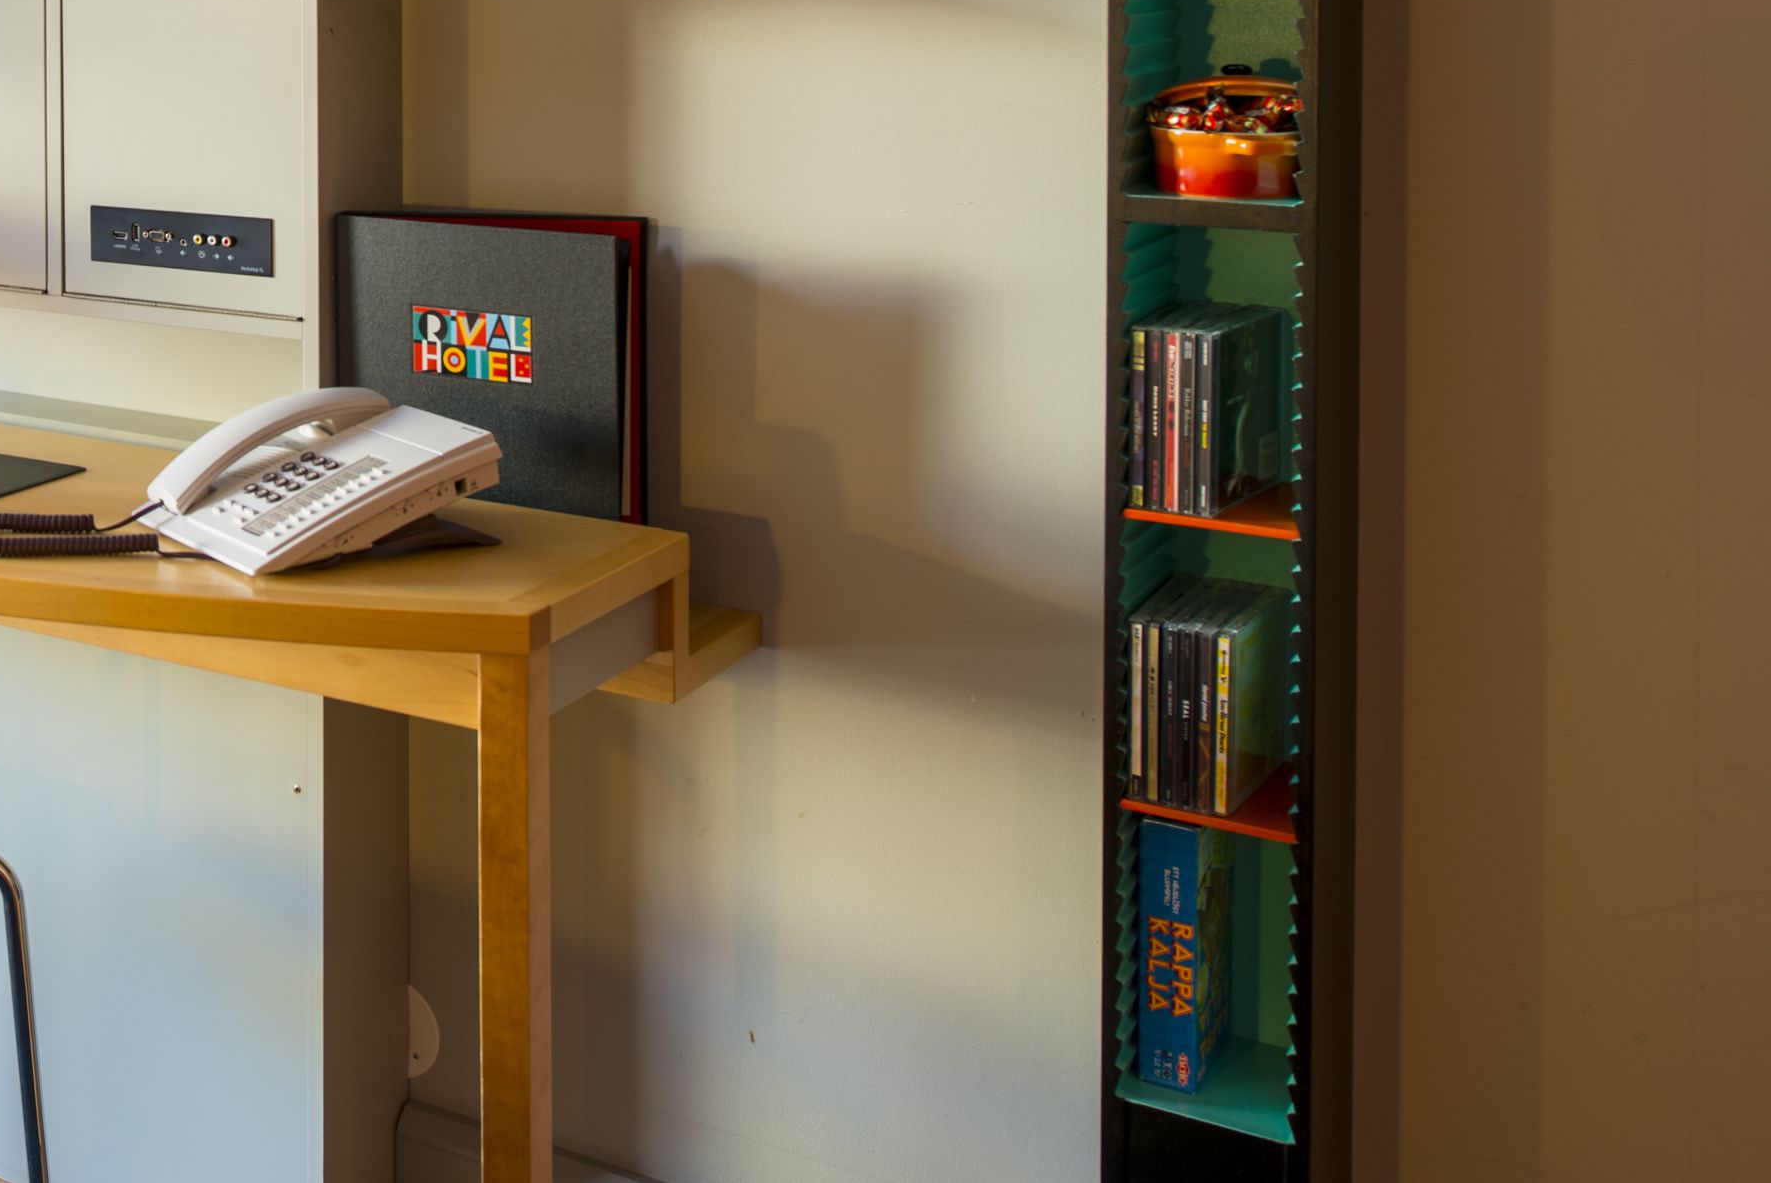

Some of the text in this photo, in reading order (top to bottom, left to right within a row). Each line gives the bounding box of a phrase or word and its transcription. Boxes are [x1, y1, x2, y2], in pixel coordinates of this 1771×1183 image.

[421, 339, 532, 383] HOTEL
[1147, 915, 1172, 1011] KALJA
[1171, 921, 1195, 1018] RAPPA
